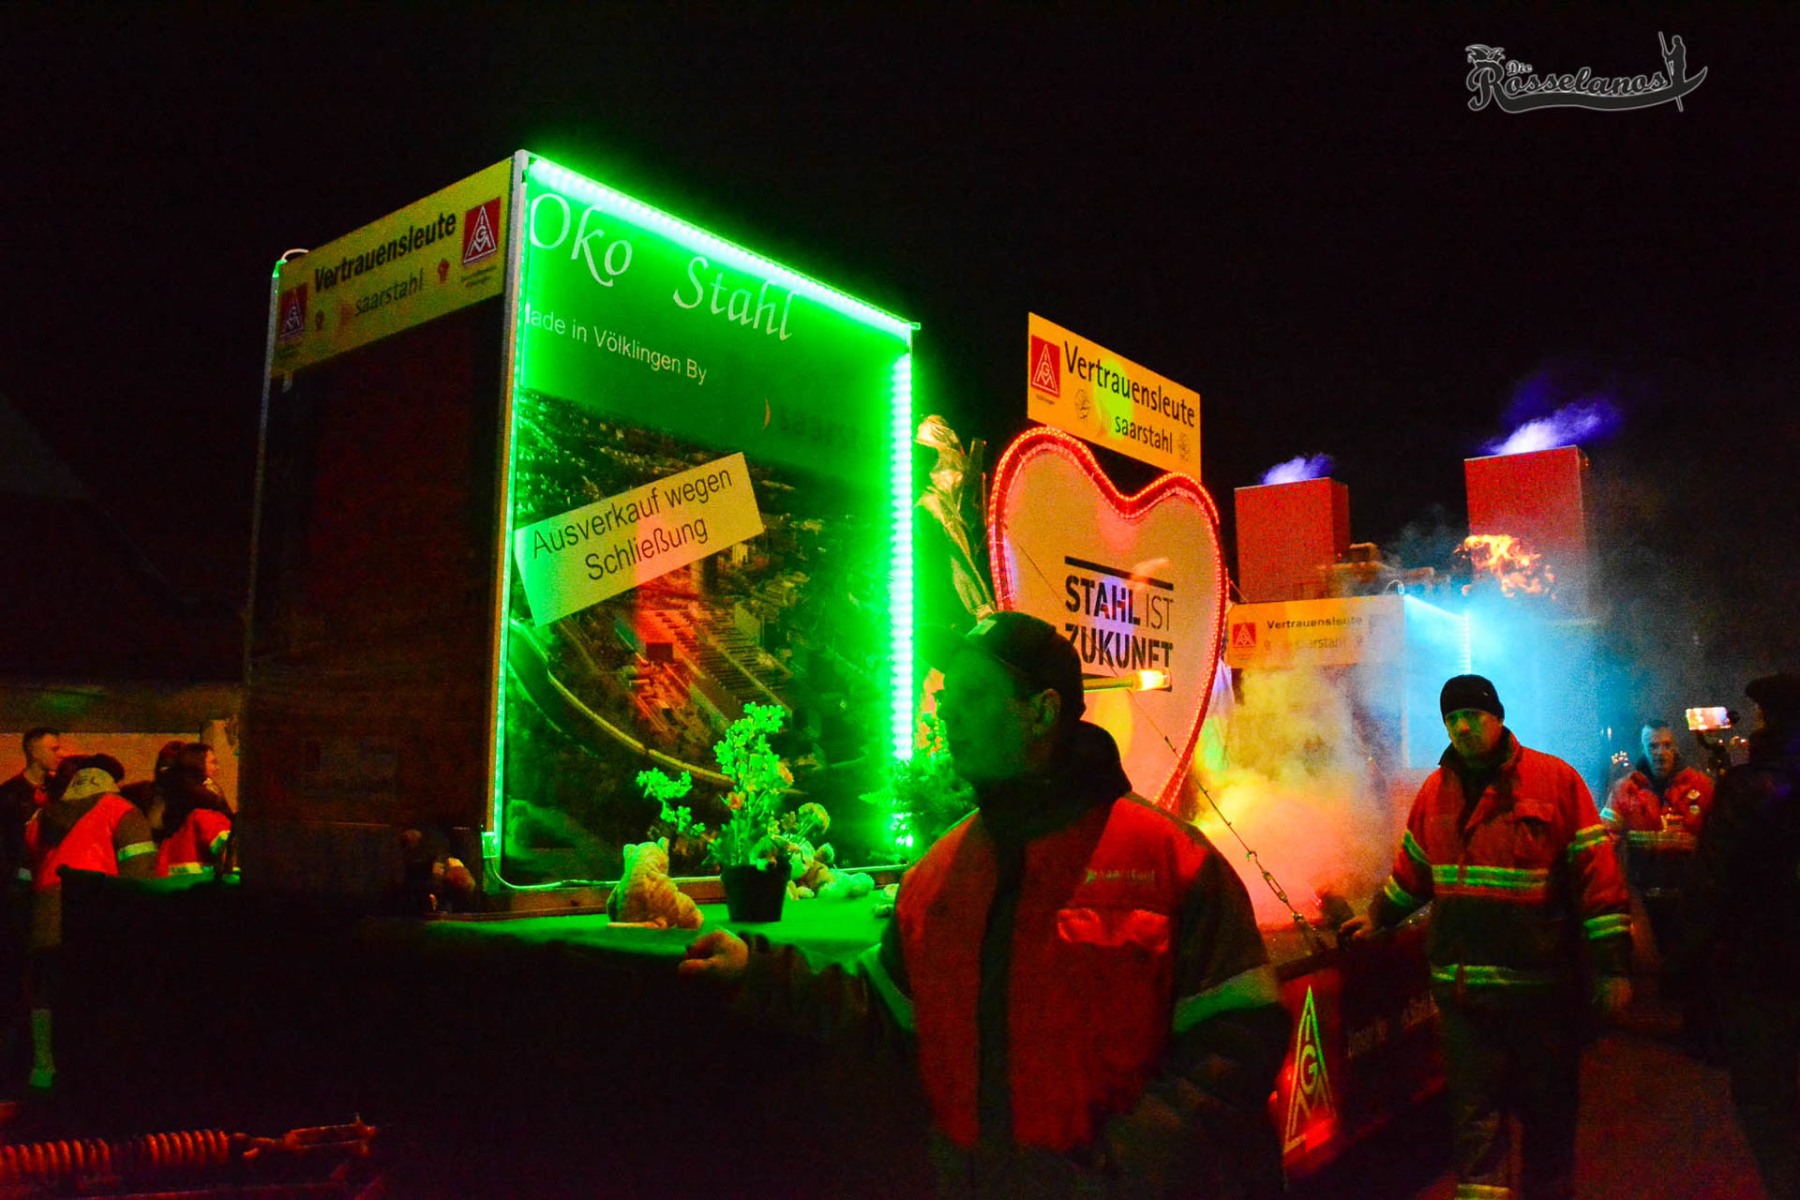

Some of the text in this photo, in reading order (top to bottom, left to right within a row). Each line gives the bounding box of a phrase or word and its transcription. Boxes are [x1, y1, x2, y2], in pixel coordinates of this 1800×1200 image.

[314, 212, 456, 293] Vertrauensleute
[355, 268, 424, 317] saarstahl
[673, 257, 800, 342] Stahl
[525, 303, 707, 385] ade in Völklingen By
[1064, 340, 1195, 428] Vertrauensleute
[1115, 415, 1173, 454] saarstahl
[534, 469, 733, 559] Ausverkauf wegen
[585, 518, 709, 580] Schließung
[1065, 575, 1174, 633] STAHL IST
[1065, 622, 1174, 671] ZUKUNFT
